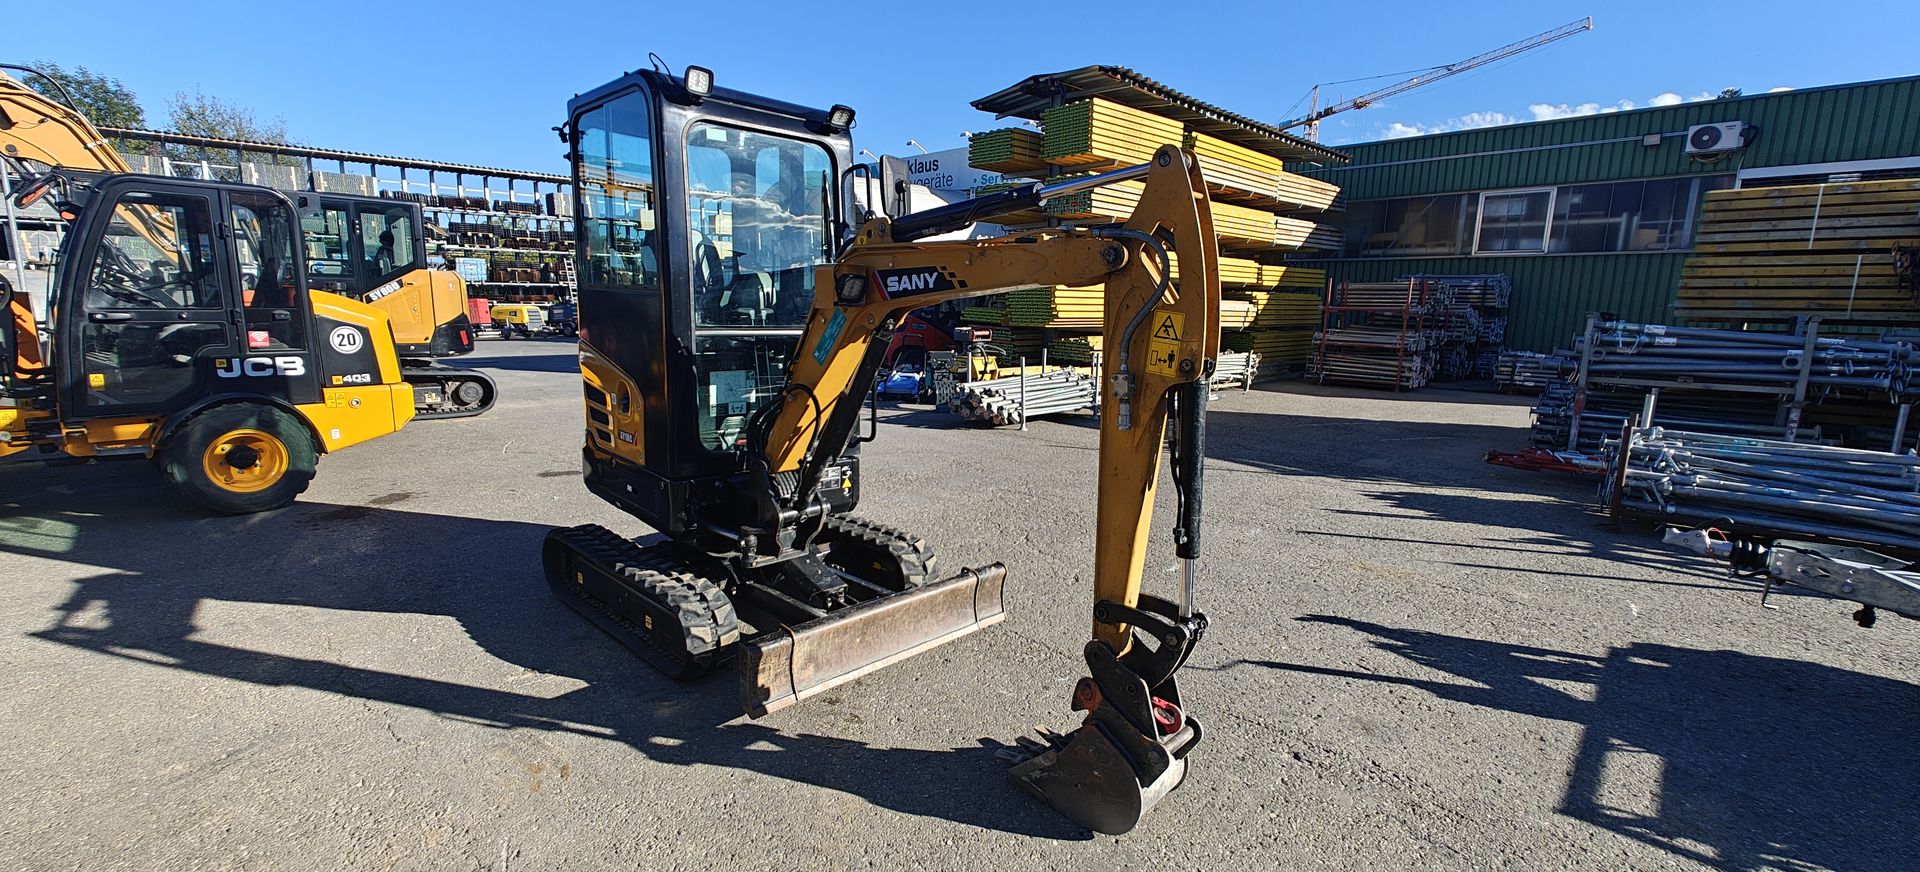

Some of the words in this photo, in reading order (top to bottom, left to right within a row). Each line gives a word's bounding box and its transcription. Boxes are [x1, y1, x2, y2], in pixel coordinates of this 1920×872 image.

[887, 272, 938, 292] SANY
[336, 333, 356, 347] 20
[217, 356, 305, 378] JCB
[343, 373, 371, 383] 403
